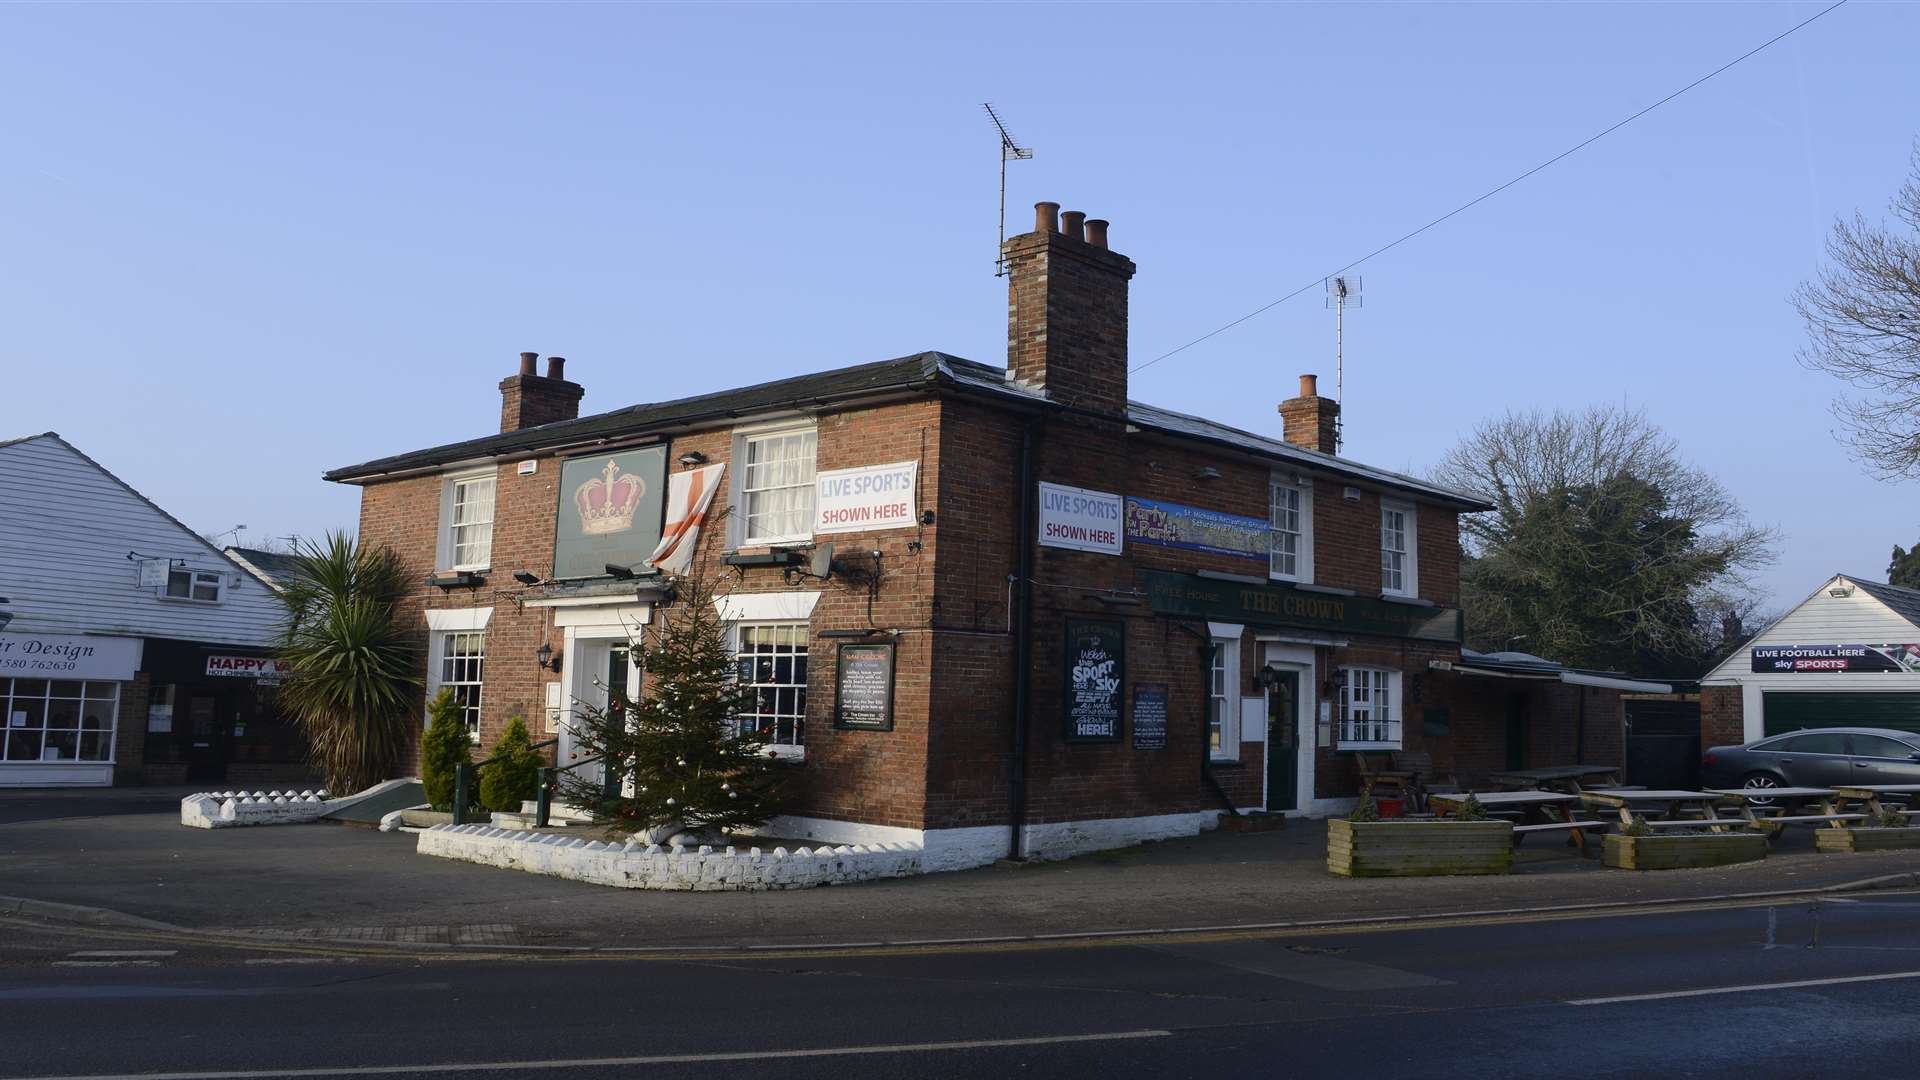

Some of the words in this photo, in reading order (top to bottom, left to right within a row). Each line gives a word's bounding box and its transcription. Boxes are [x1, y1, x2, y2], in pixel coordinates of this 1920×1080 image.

[821, 479, 851, 498] LIVE
[853, 472, 911, 496] SPORTS
[822, 507, 870, 524] SHOWN
[874, 503, 908, 519] HERE
[1044, 492, 1070, 513] LIVE
[1073, 497, 1118, 520] SPORTS
[1127, 501, 1168, 528] Party
[1046, 522, 1087, 541] SHOWN
[1089, 529, 1115, 545] HERE
[1240, 590, 1280, 614] THE
[1282, 593, 1345, 624] CROWN
[22, 640, 97, 662] Design
[1755, 650, 1778, 658] LIVE
[1781, 649, 1835, 658] FOOTBALL
[1837, 648, 1865, 657] HERE
[209, 657, 267, 672] HAPPY
[1072, 661, 1115, 683] SPORT
[1774, 660, 1793, 670] sky
[1796, 659, 1845, 669] SPORTS
[1077, 720, 1113, 737] HERE!
